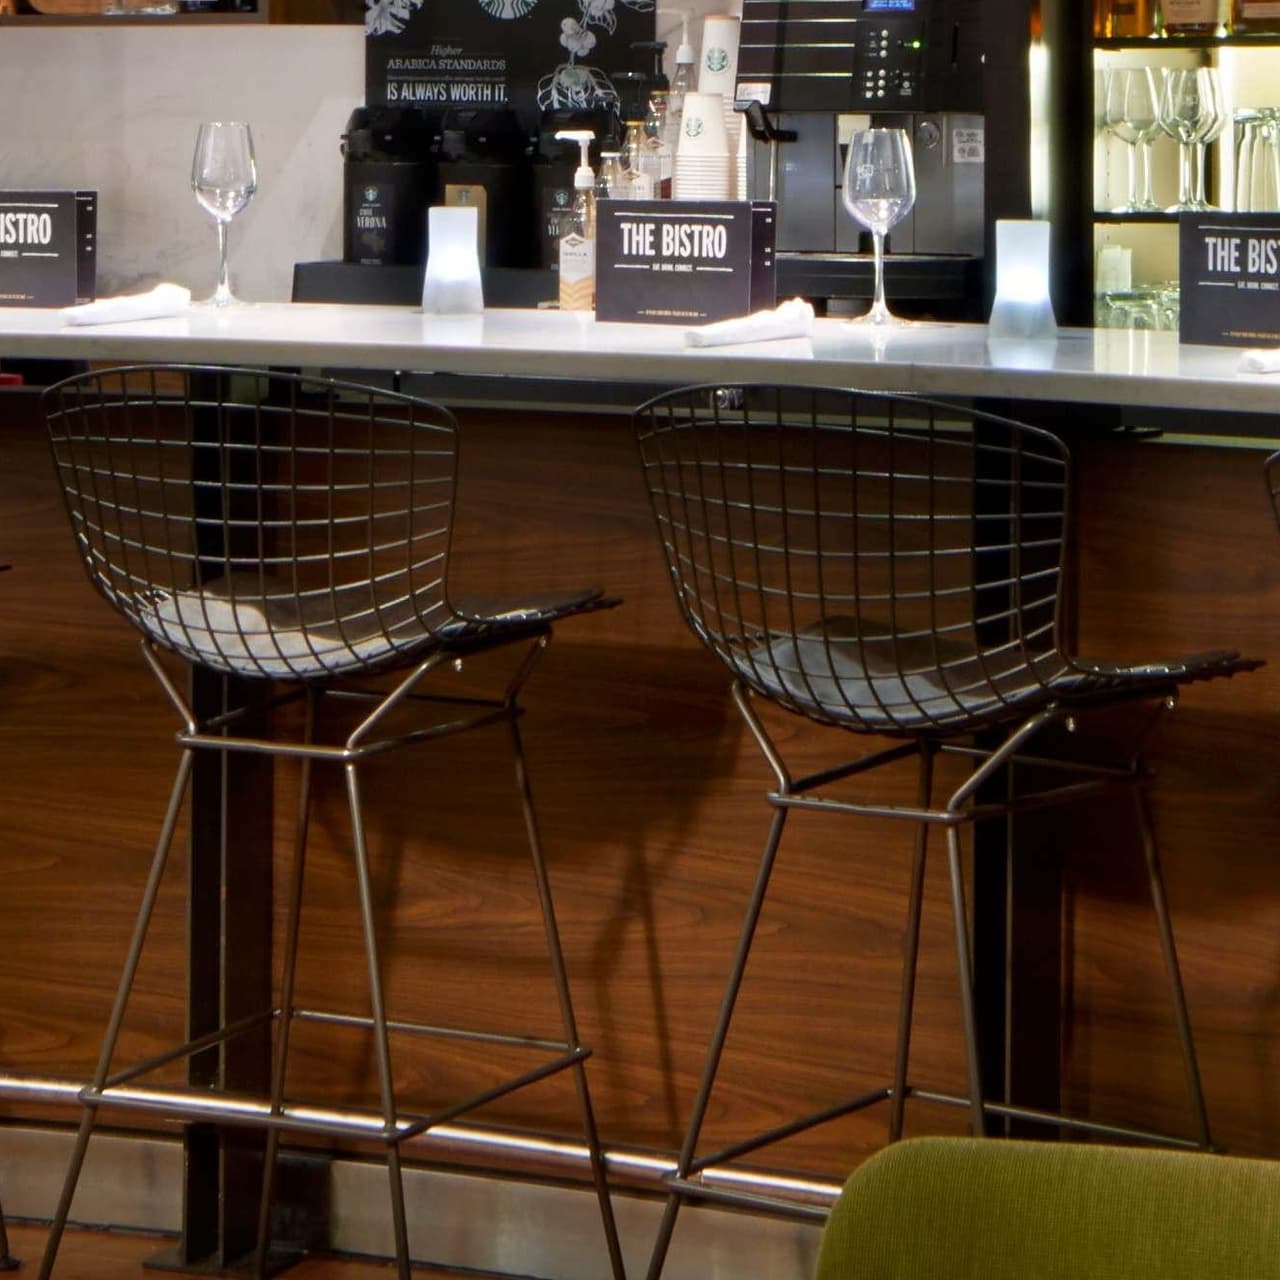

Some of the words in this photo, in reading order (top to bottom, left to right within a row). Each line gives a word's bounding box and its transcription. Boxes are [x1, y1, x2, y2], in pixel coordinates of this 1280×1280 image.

[431, 44, 463, 57] Higher
[386, 59, 436, 70] ARABICA
[438, 59, 507, 71] STANDARDS
[387, 82, 398, 100] IS
[400, 82, 447, 101] ALWAYS
[450, 83, 491, 101] WORTH
[495, 84, 508, 102] IT.
[620, 222, 656, 256] THE
[662, 223, 727, 258] BISTRO
[1205, 236, 1240, 272] THE
